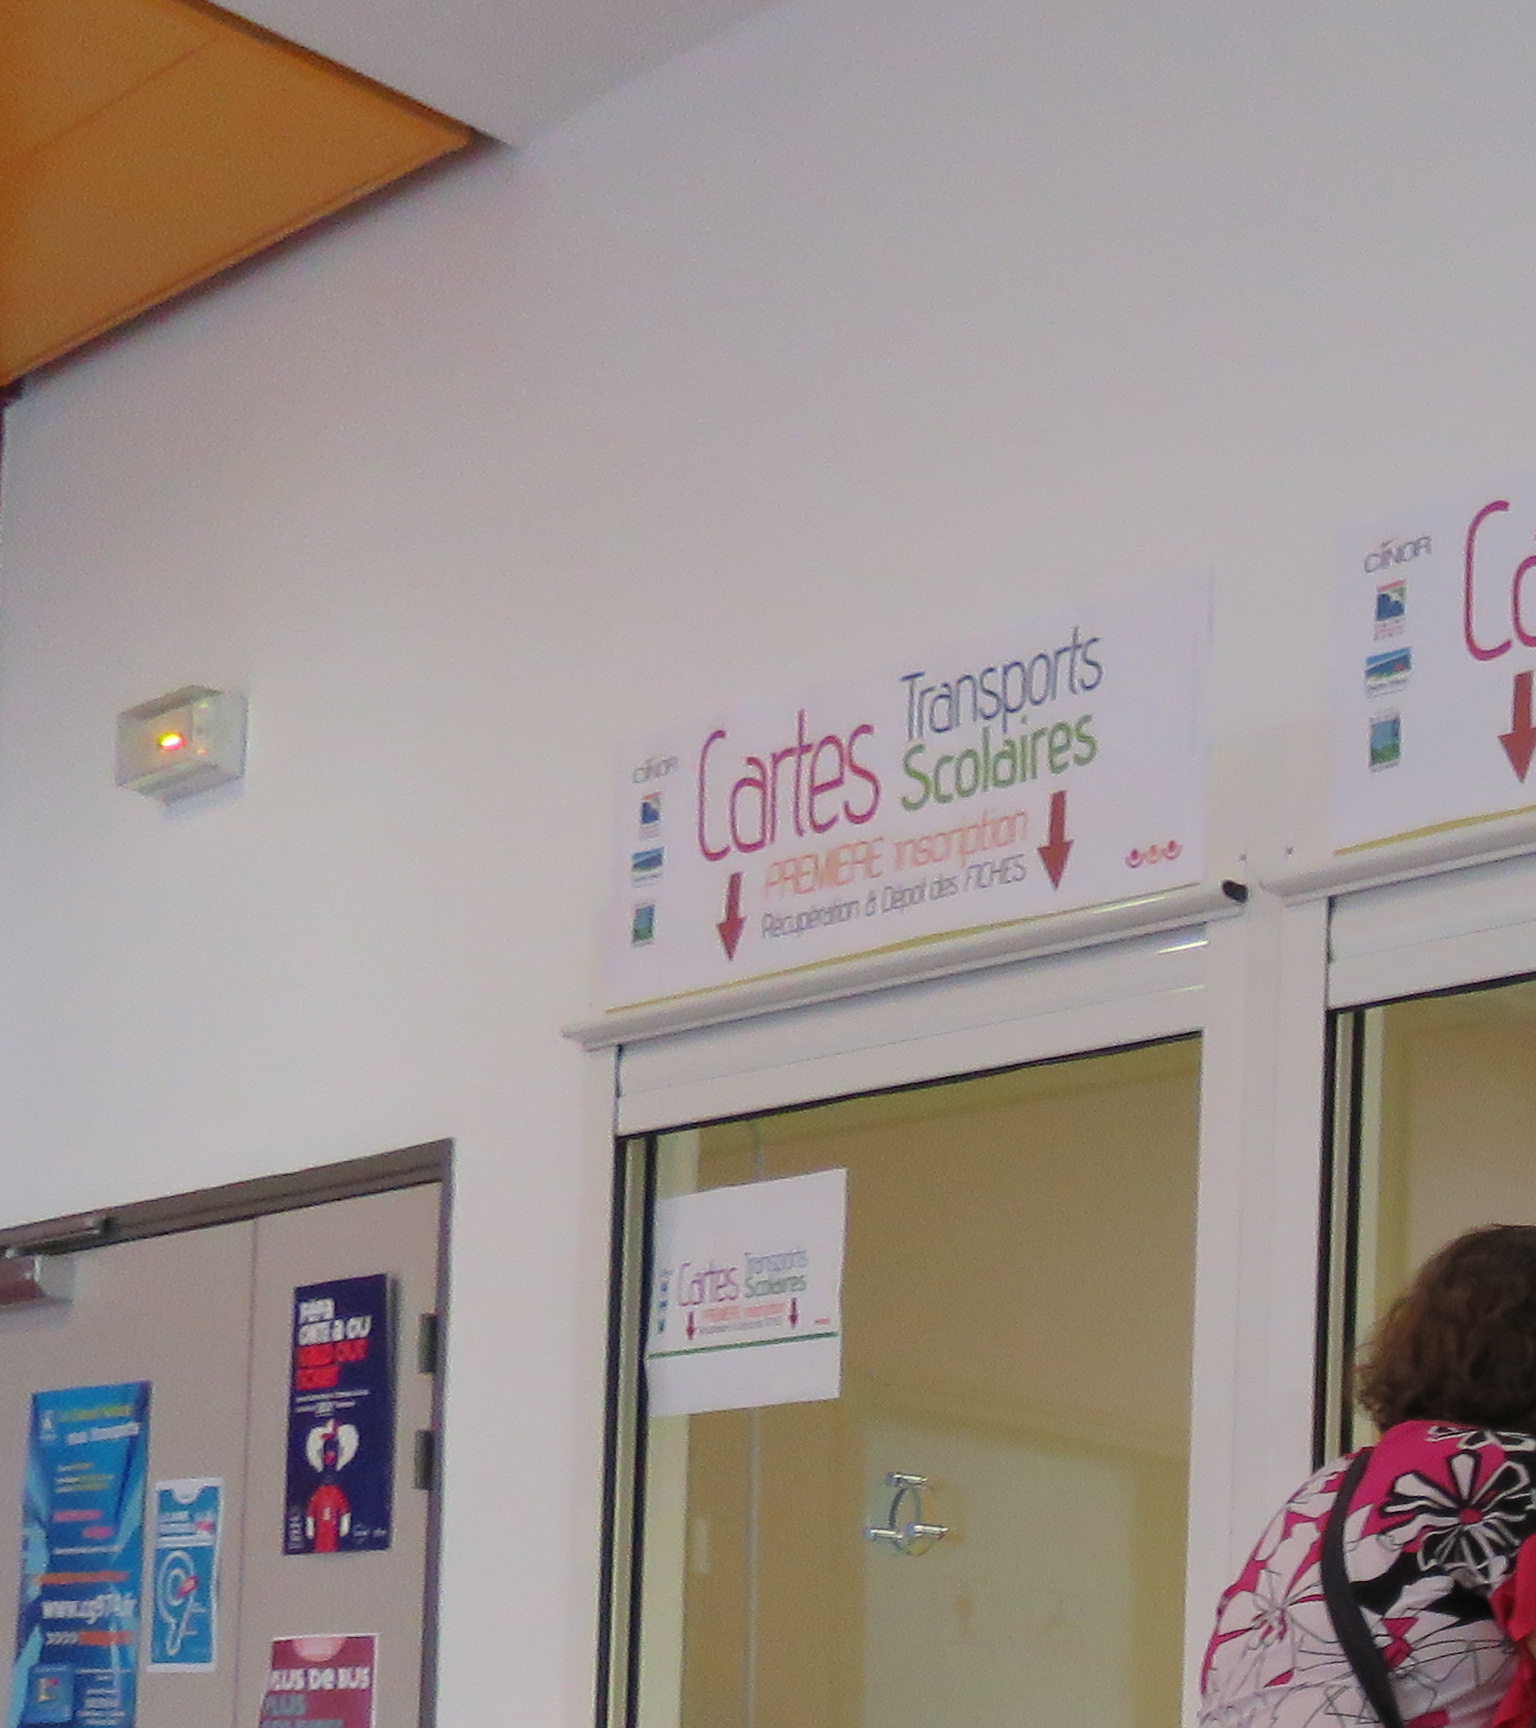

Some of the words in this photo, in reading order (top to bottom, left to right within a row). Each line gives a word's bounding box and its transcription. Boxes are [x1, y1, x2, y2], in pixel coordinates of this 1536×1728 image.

[900, 626, 1104, 742] Transports
[697, 708, 881, 862] Cartes
[900, 714, 1098, 812] Scolaires
